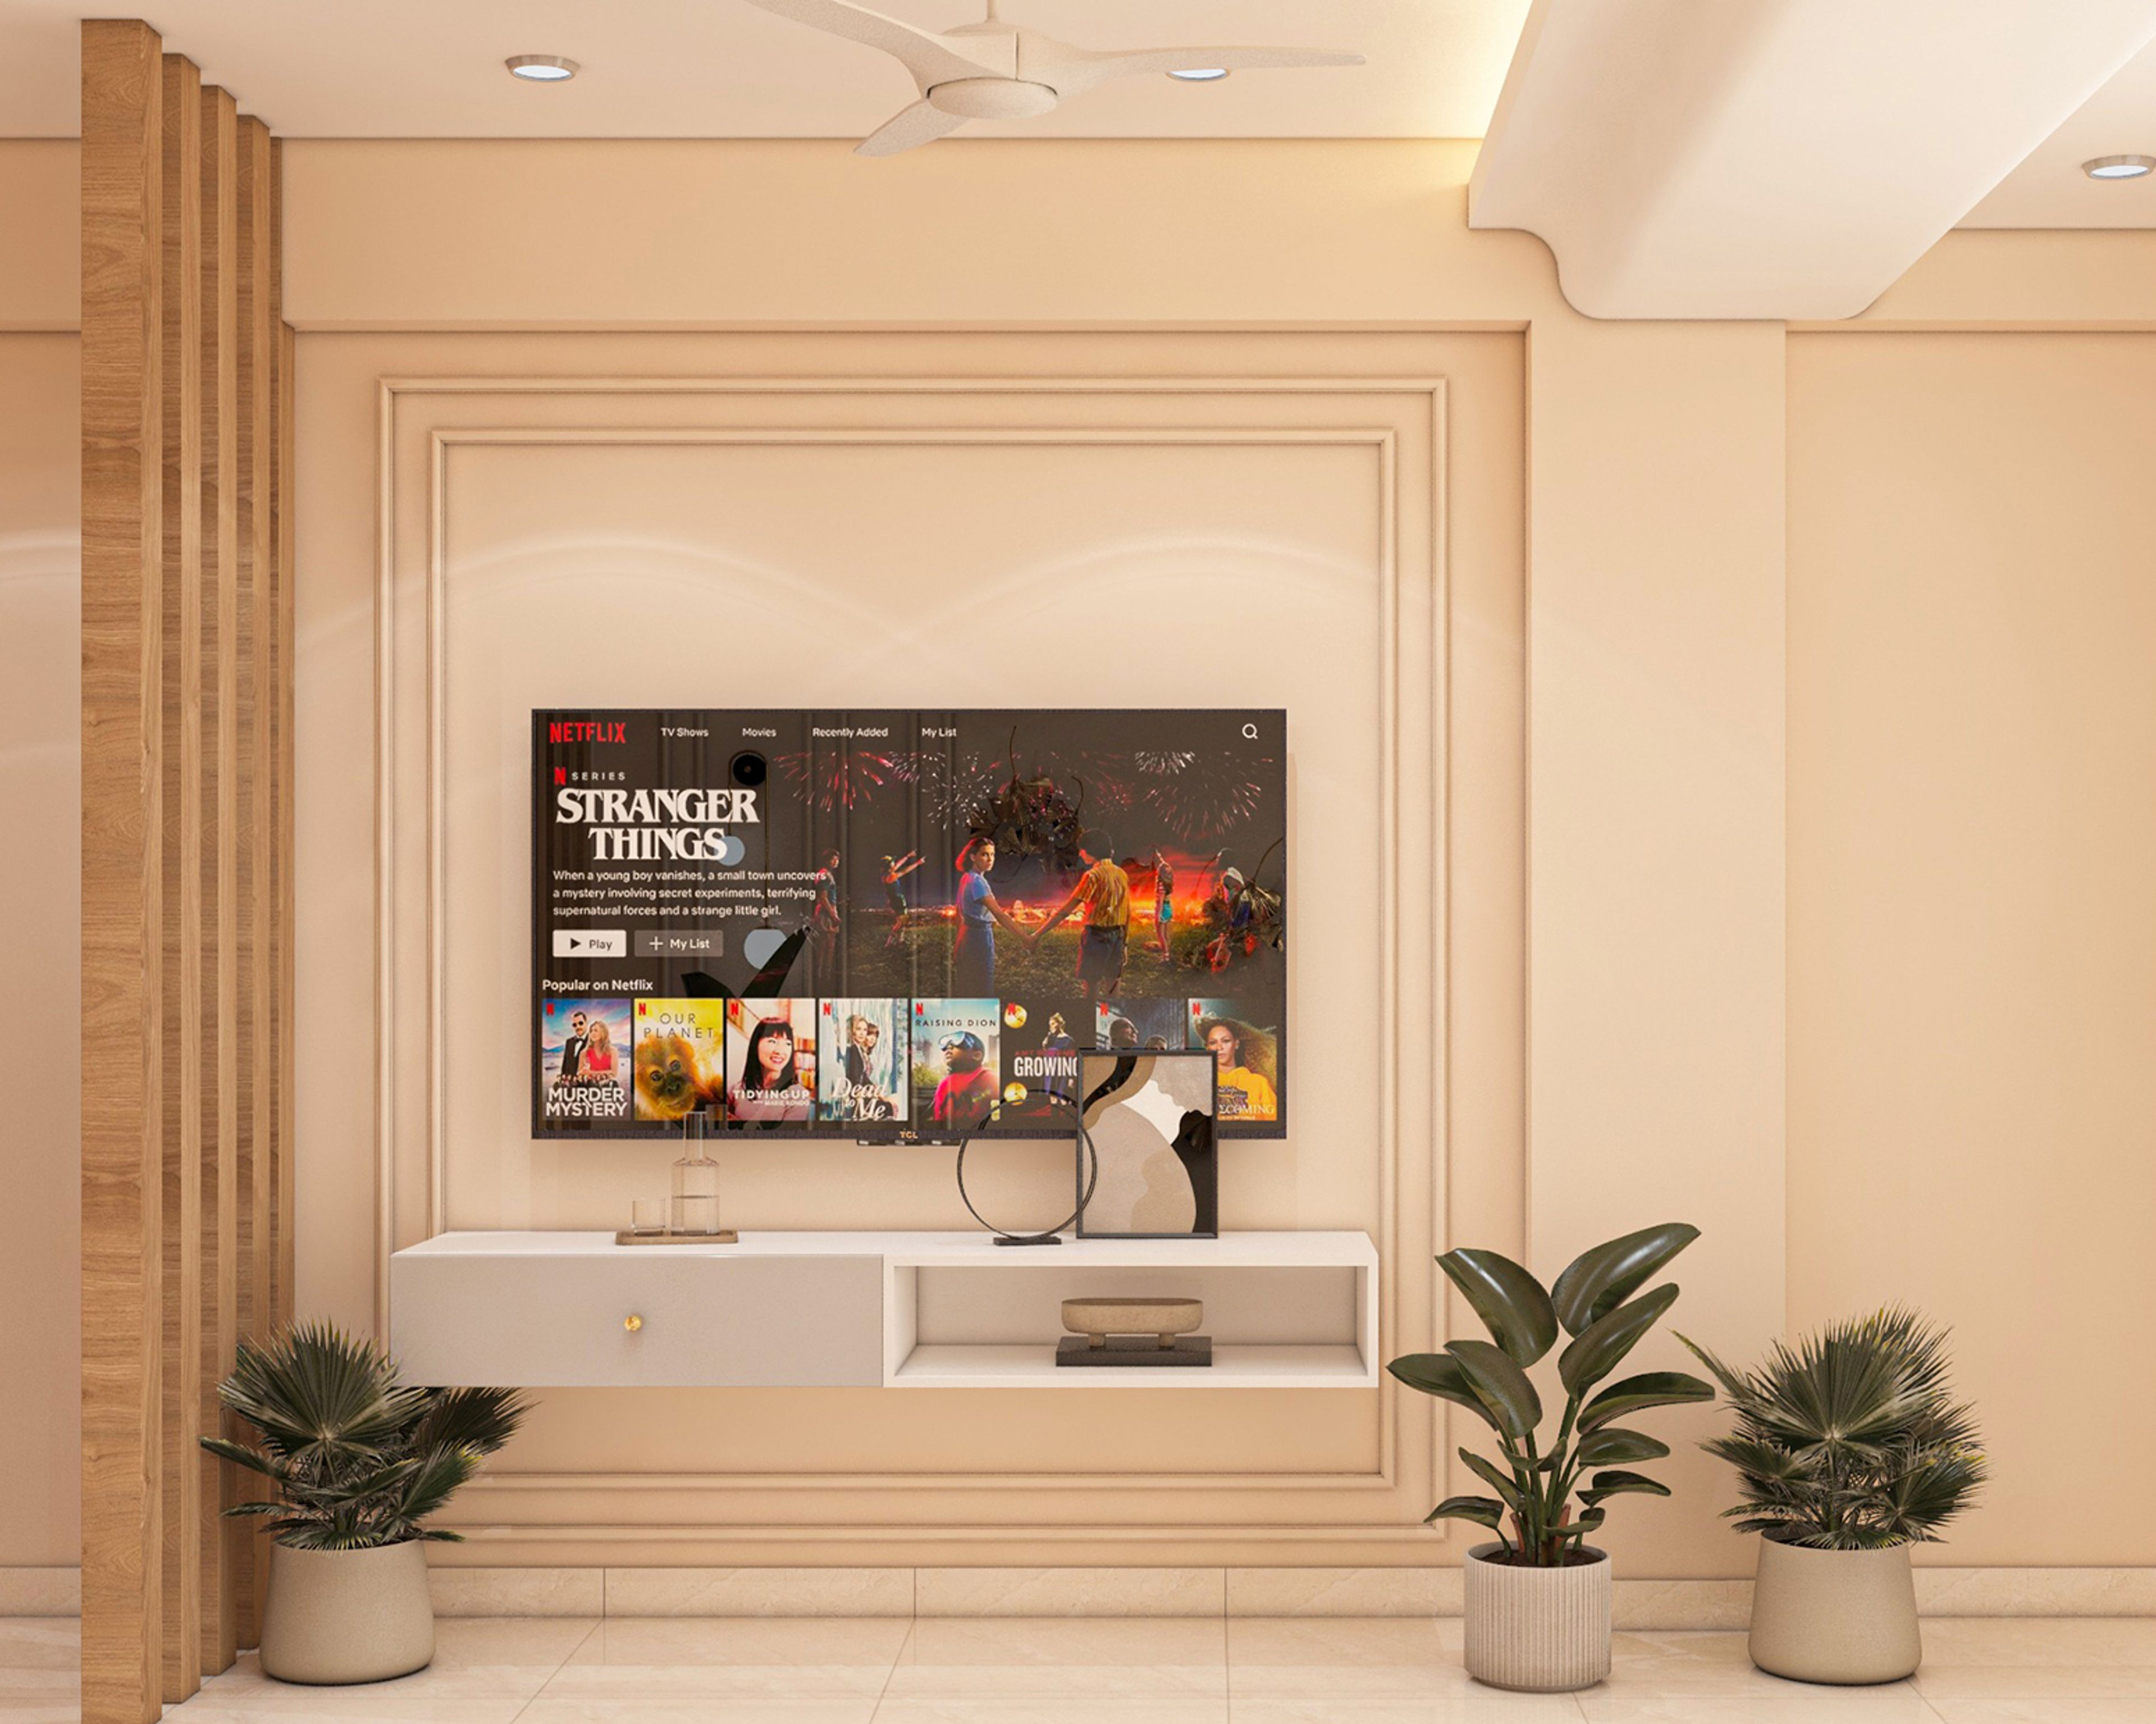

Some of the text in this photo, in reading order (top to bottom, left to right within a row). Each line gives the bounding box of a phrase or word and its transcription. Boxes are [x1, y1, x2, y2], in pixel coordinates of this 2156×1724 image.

[549, 722, 626, 744] NETFLIX
[661, 727, 709, 737] TV Shows
[742, 728, 777, 737] Movies
[812, 727, 889, 738] Recently Added
[921, 727, 957, 738] My List
[571, 772, 626, 781] SERIES
[555, 788, 760, 823] STRANGER
[587, 827, 728, 860] THINGS
[553, 871, 585, 881] When
[596, 873, 631, 883] young
[632, 871, 653, 882] boy
[655, 871, 706, 882] vanishes,
[717, 871, 746, 881] small
[747, 872, 775, 881] town
[562, 889, 606, 900] mystery
[607, 888, 656, 900] involving
[658, 889, 693, 898] secret
[695, 888, 765, 899] experiments,
[767, 888, 816, 900] terrifying
[553, 905, 621, 917] supernatural
[623, 905, 657, 915] forces
[659, 906, 680, 915] and
[691, 906, 733, 918] strange
[735, 906, 759, 915] little
[761, 906, 782, 918] girl.
[589, 939, 613, 951] Play
[670, 939, 710, 951] My List
[542, 979, 654, 993] Popular on Netflix
[659, 1012, 696, 1025] OUR
[643, 1028, 714, 1038] PLANET
[831, 1077, 889, 1098] Dead
[548, 1087, 625, 1103] MURDER
[545, 1102, 628, 1116] MYSTERY
[851, 1097, 886, 1120] Me
[899, 1130, 919, 1139] TCL
